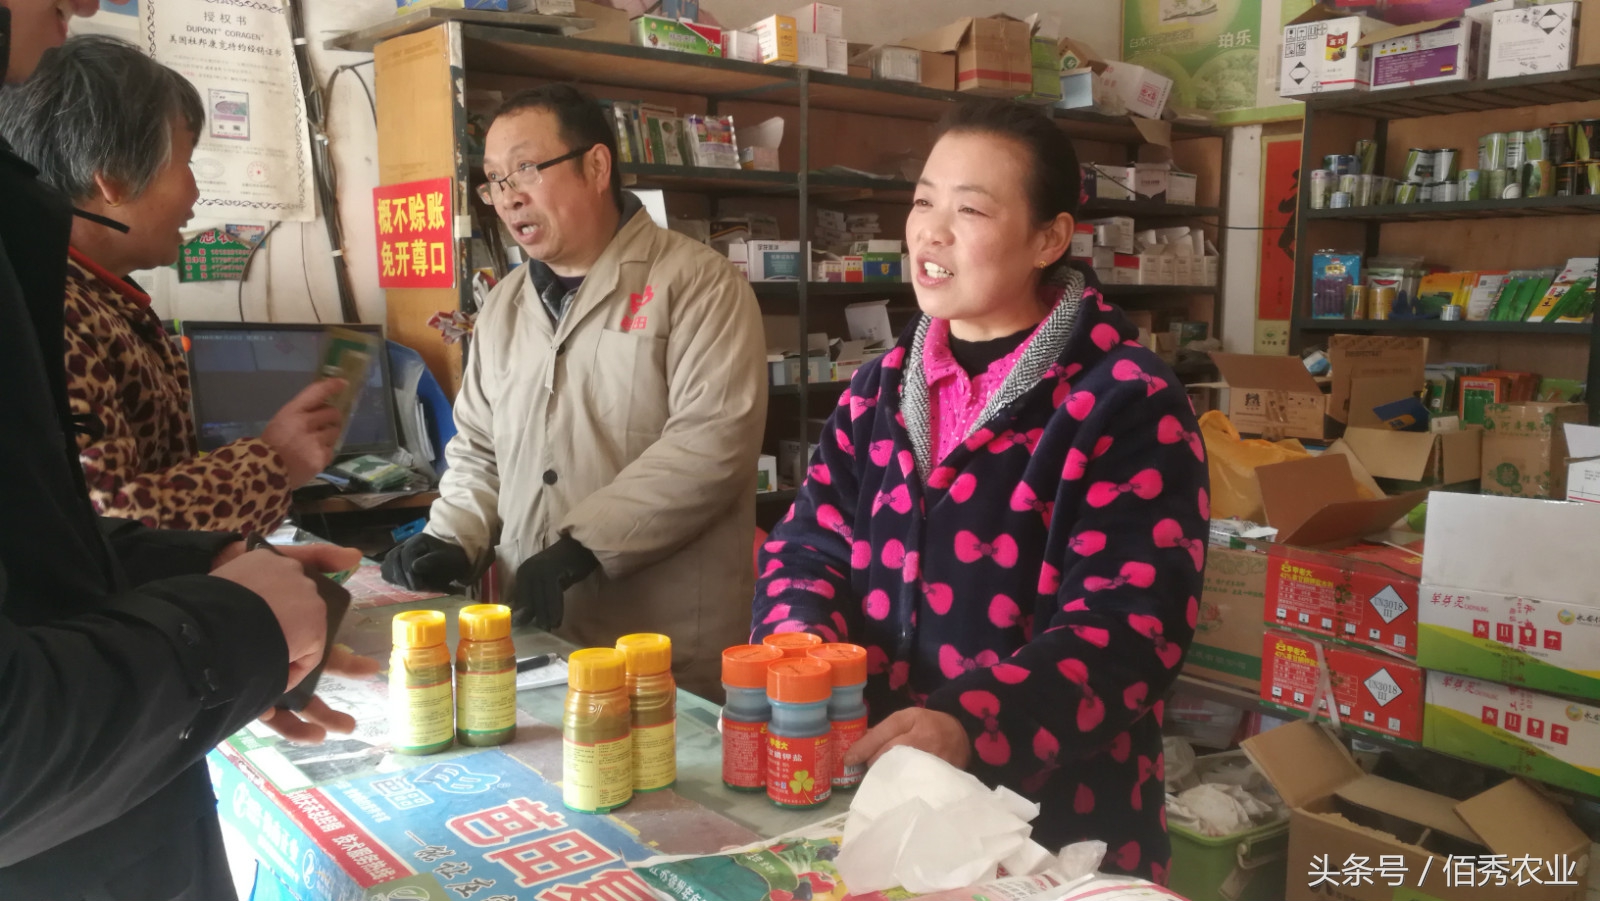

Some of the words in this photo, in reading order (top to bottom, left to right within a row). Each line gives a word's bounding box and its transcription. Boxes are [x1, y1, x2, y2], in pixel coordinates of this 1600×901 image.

[204, 11, 247, 26] 授权书
[1217, 29, 1252, 49] 珀乐
[377, 191, 446, 235] 概不赊账
[381, 239, 446, 277] 免开尊口
[1374, 597, 1404, 612] UN3018
[1368, 680, 1398, 695] UN3018
